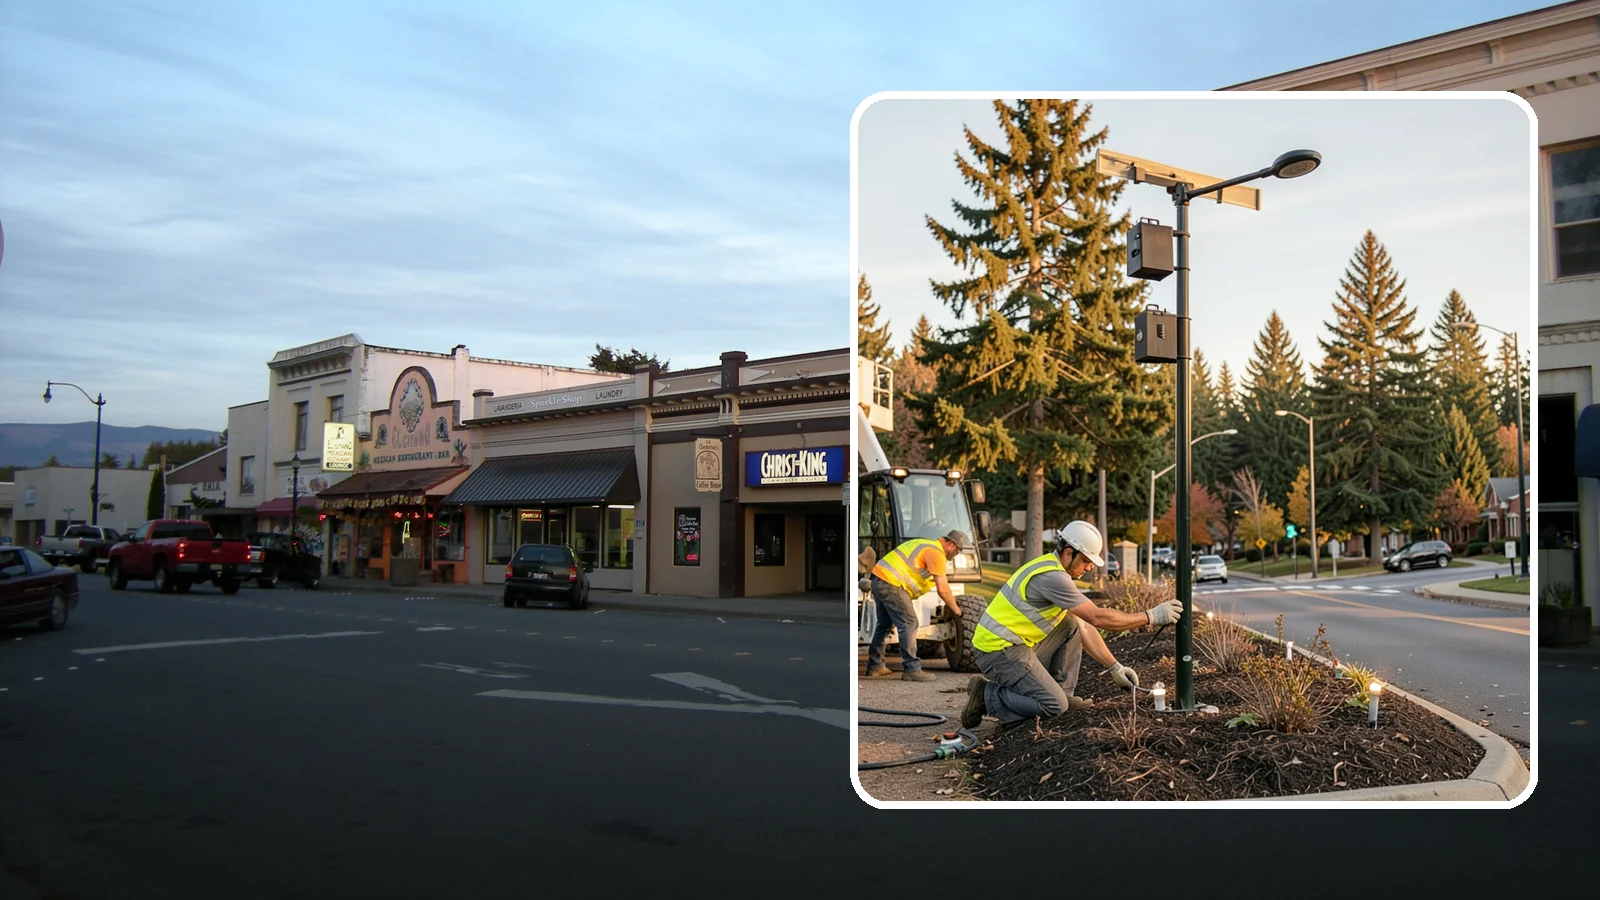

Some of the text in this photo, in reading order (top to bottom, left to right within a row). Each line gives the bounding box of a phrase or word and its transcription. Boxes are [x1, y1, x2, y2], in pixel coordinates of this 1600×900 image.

[494, 389, 623, 412] LAVANDERIA Sparkle Shop LAUNDRY
[392, 426, 402, 449] EL
[373, 450, 450, 464] MEXICAN RESTAURANT BAR
[761, 450, 827, 478] CHRIST KING
[696, 480, 722, 488] Coffee House
